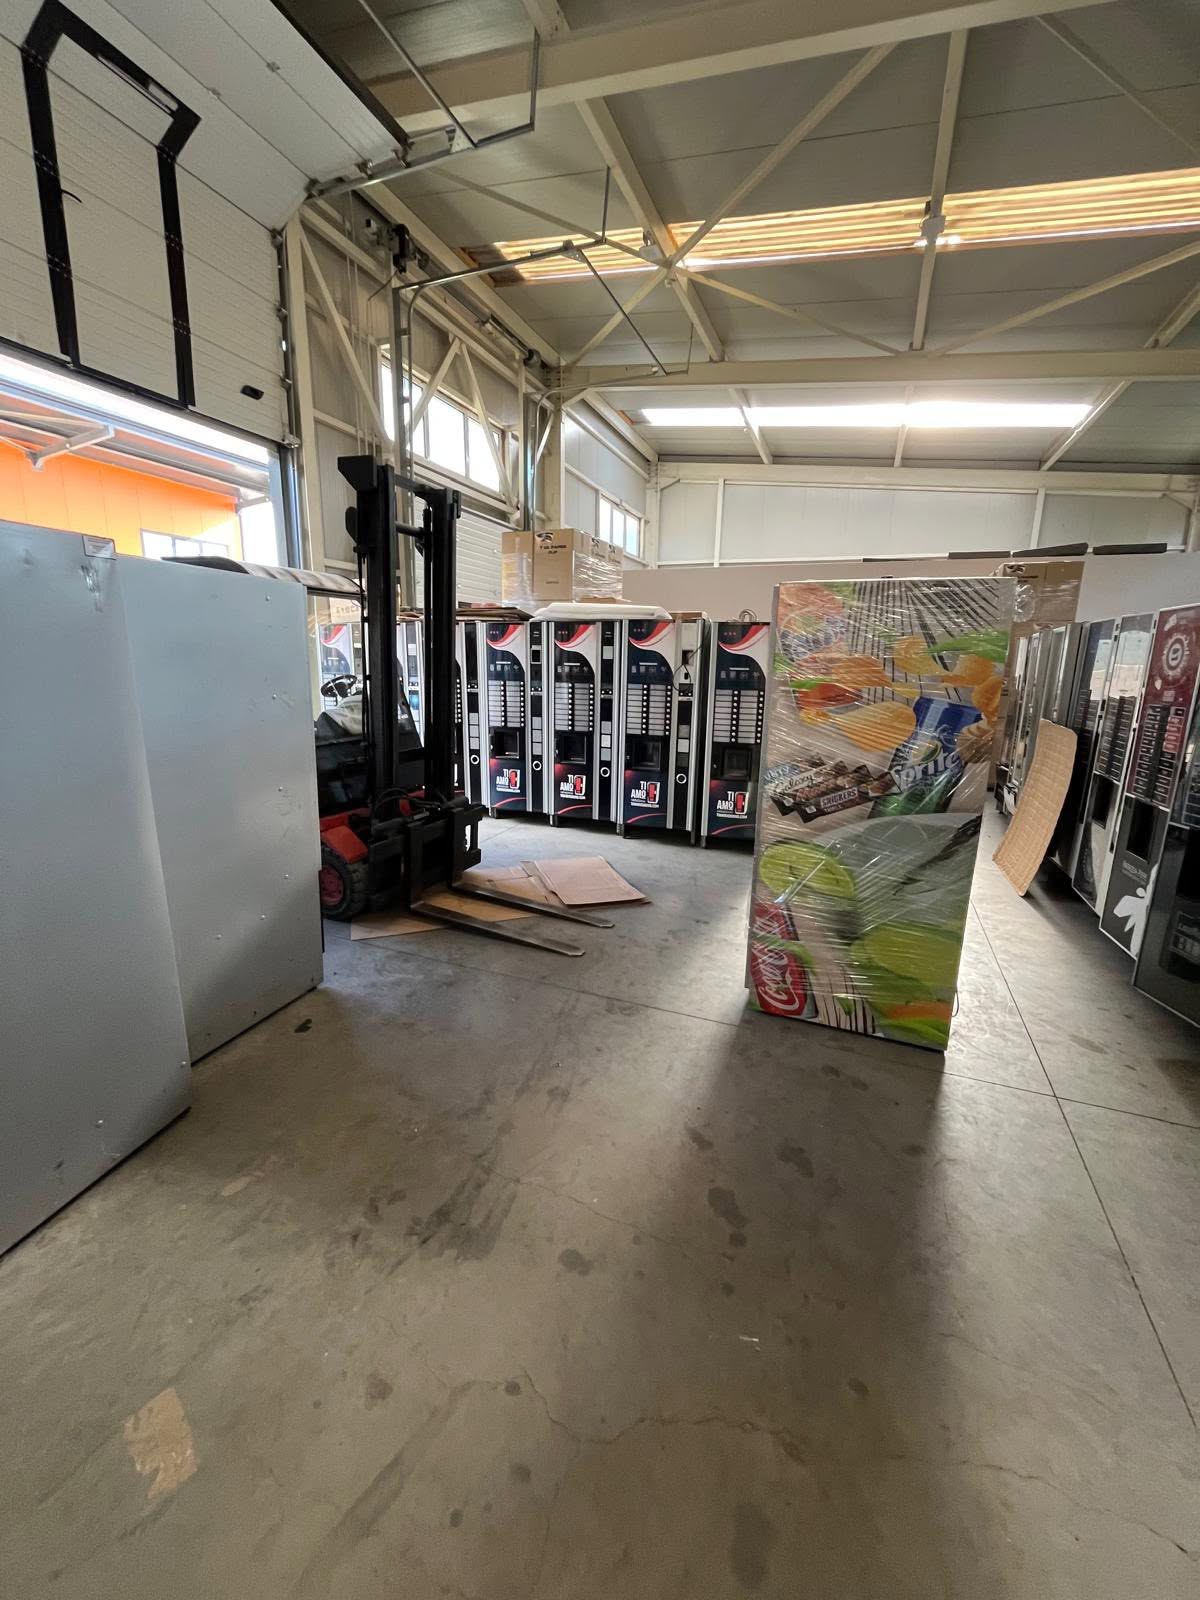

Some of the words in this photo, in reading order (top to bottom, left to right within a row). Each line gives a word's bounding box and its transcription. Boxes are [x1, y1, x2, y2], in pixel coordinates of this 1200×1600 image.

[891, 749, 961, 793] Sprite
[640, 781, 647, 790] TI
[727, 791, 734, 801] TI
